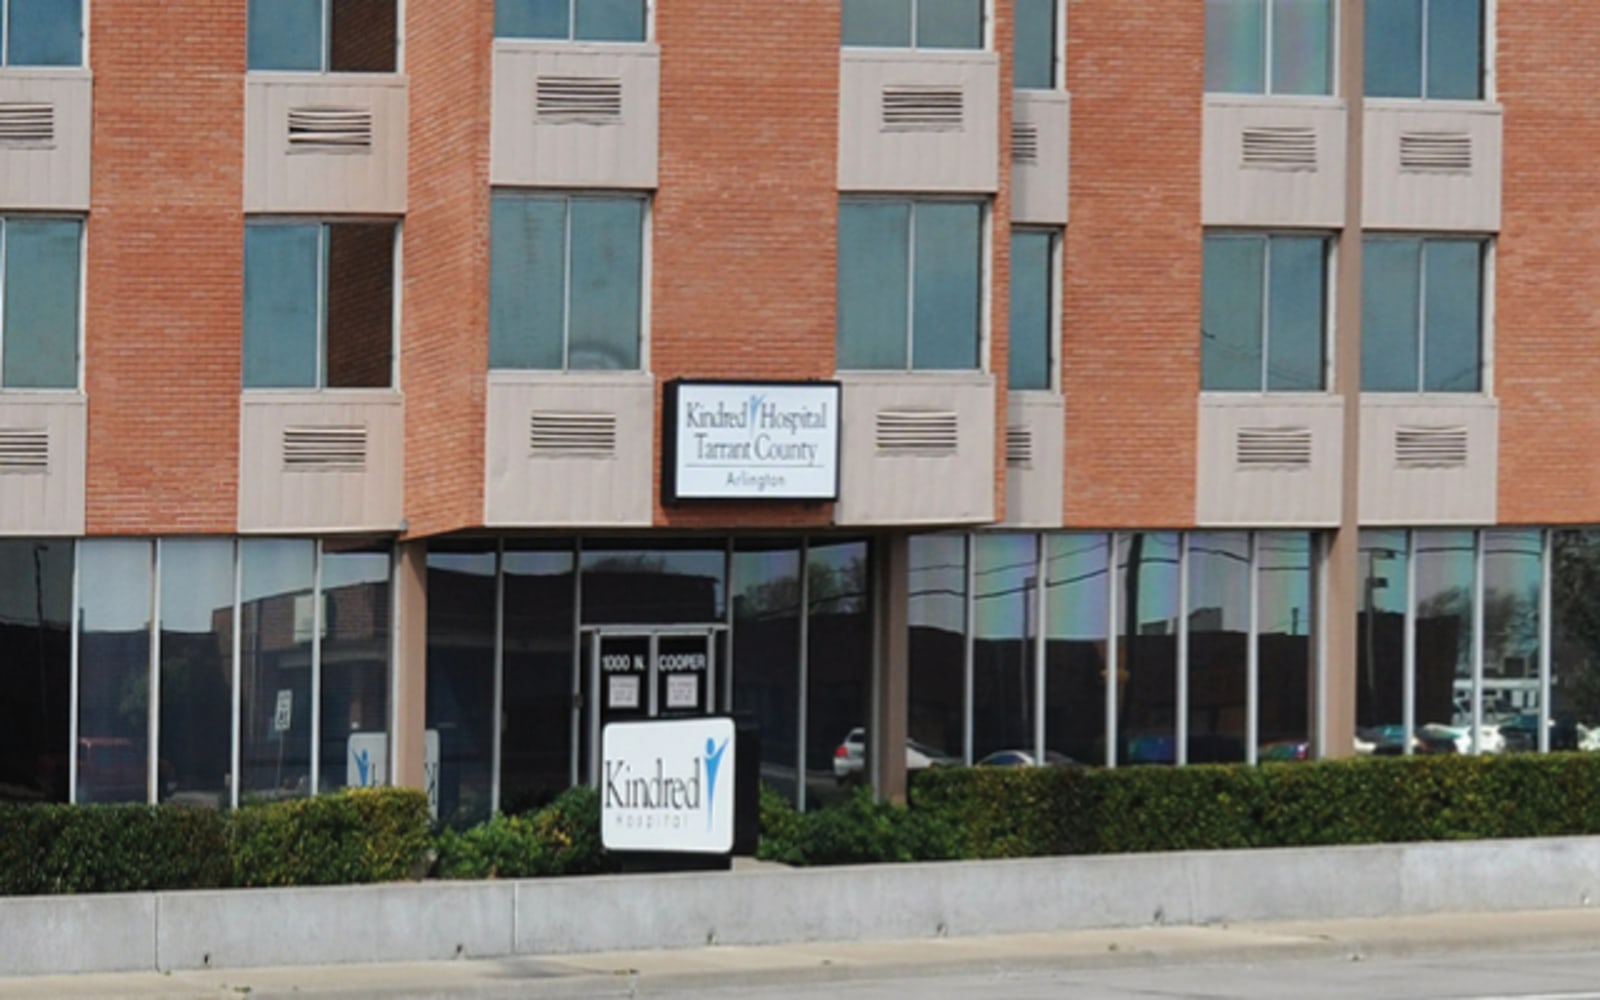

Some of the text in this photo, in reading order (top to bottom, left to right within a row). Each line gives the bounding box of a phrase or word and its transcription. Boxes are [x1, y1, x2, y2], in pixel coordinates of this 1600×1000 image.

[686, 401, 827, 435] Kindred Hospital
[694, 432, 818, 466] Tarrant County
[726, 472, 786, 492] Arlington
[602, 654, 631, 671] 1000
[658, 653, 706, 671] COOPER
[605, 757, 700, 810] Kindred
